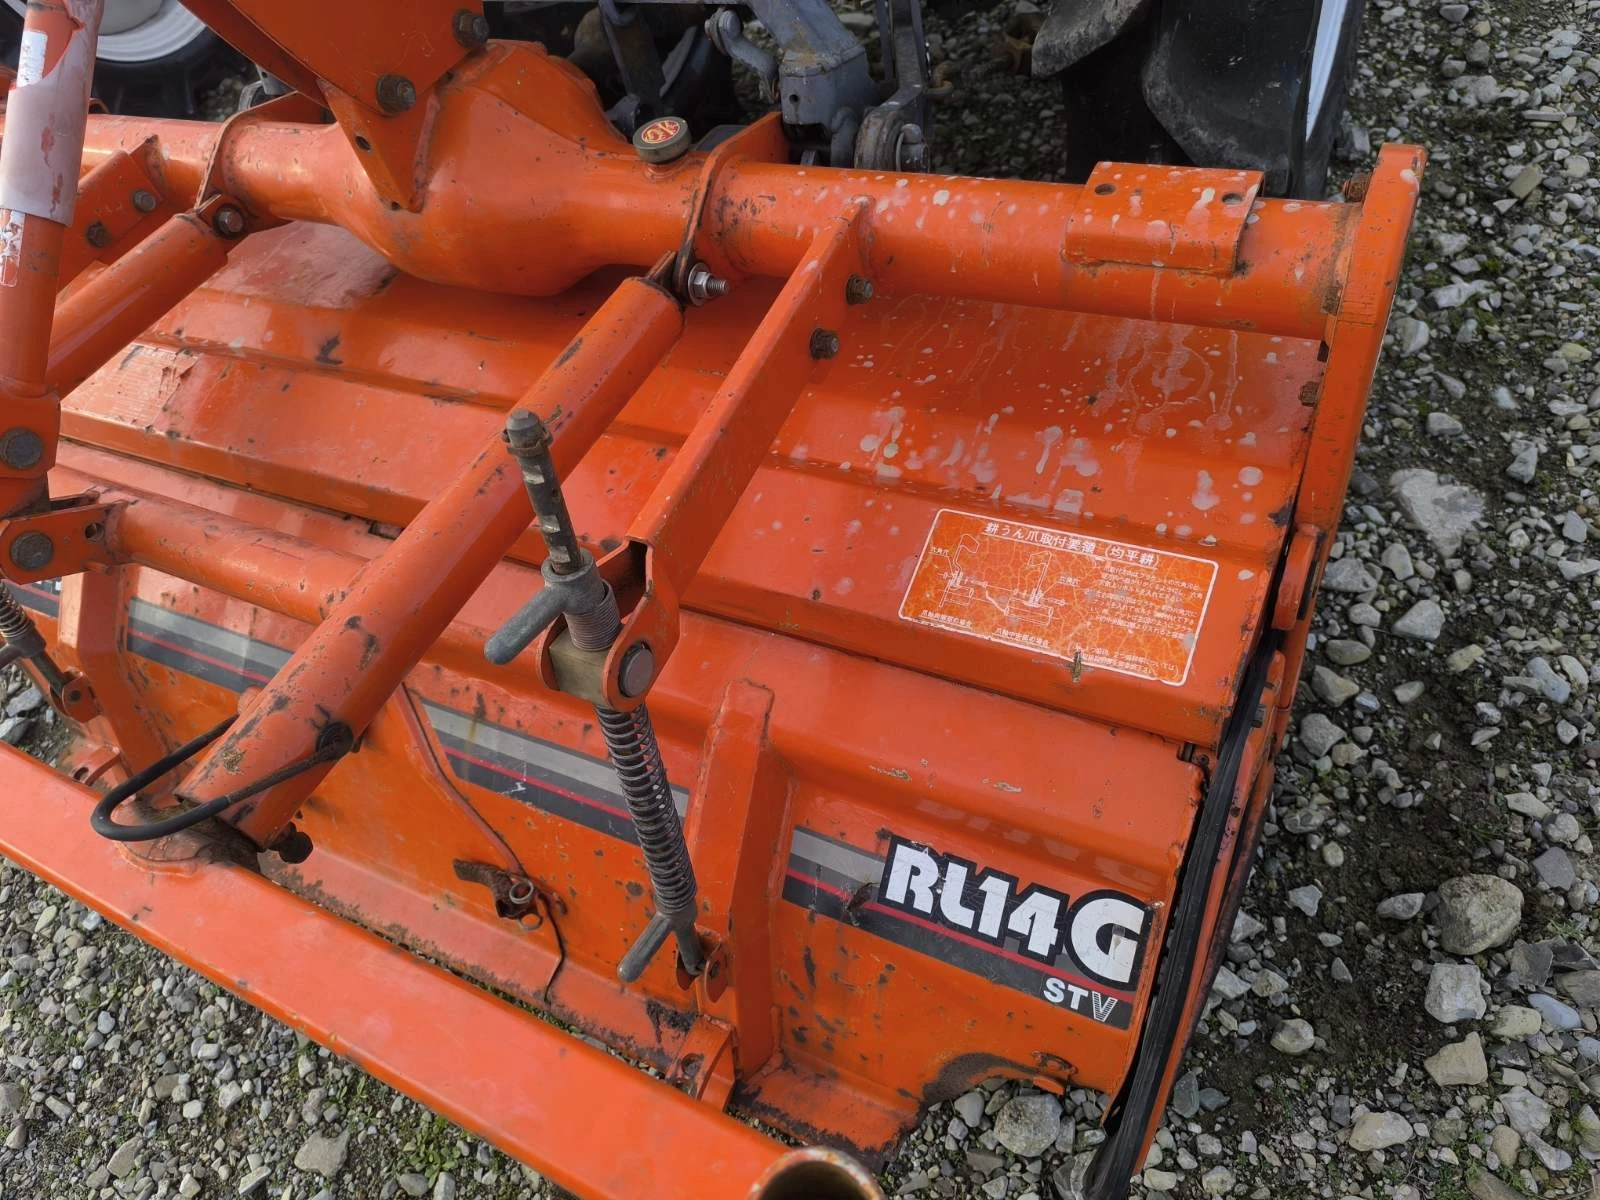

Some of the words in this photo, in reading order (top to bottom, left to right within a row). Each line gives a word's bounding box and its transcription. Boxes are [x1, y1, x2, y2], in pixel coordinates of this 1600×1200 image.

[984, 522, 1096, 553] 耕うん爪取付要領
[885, 843, 1145, 983] RL14G
[1043, 977, 1118, 1022] STV
